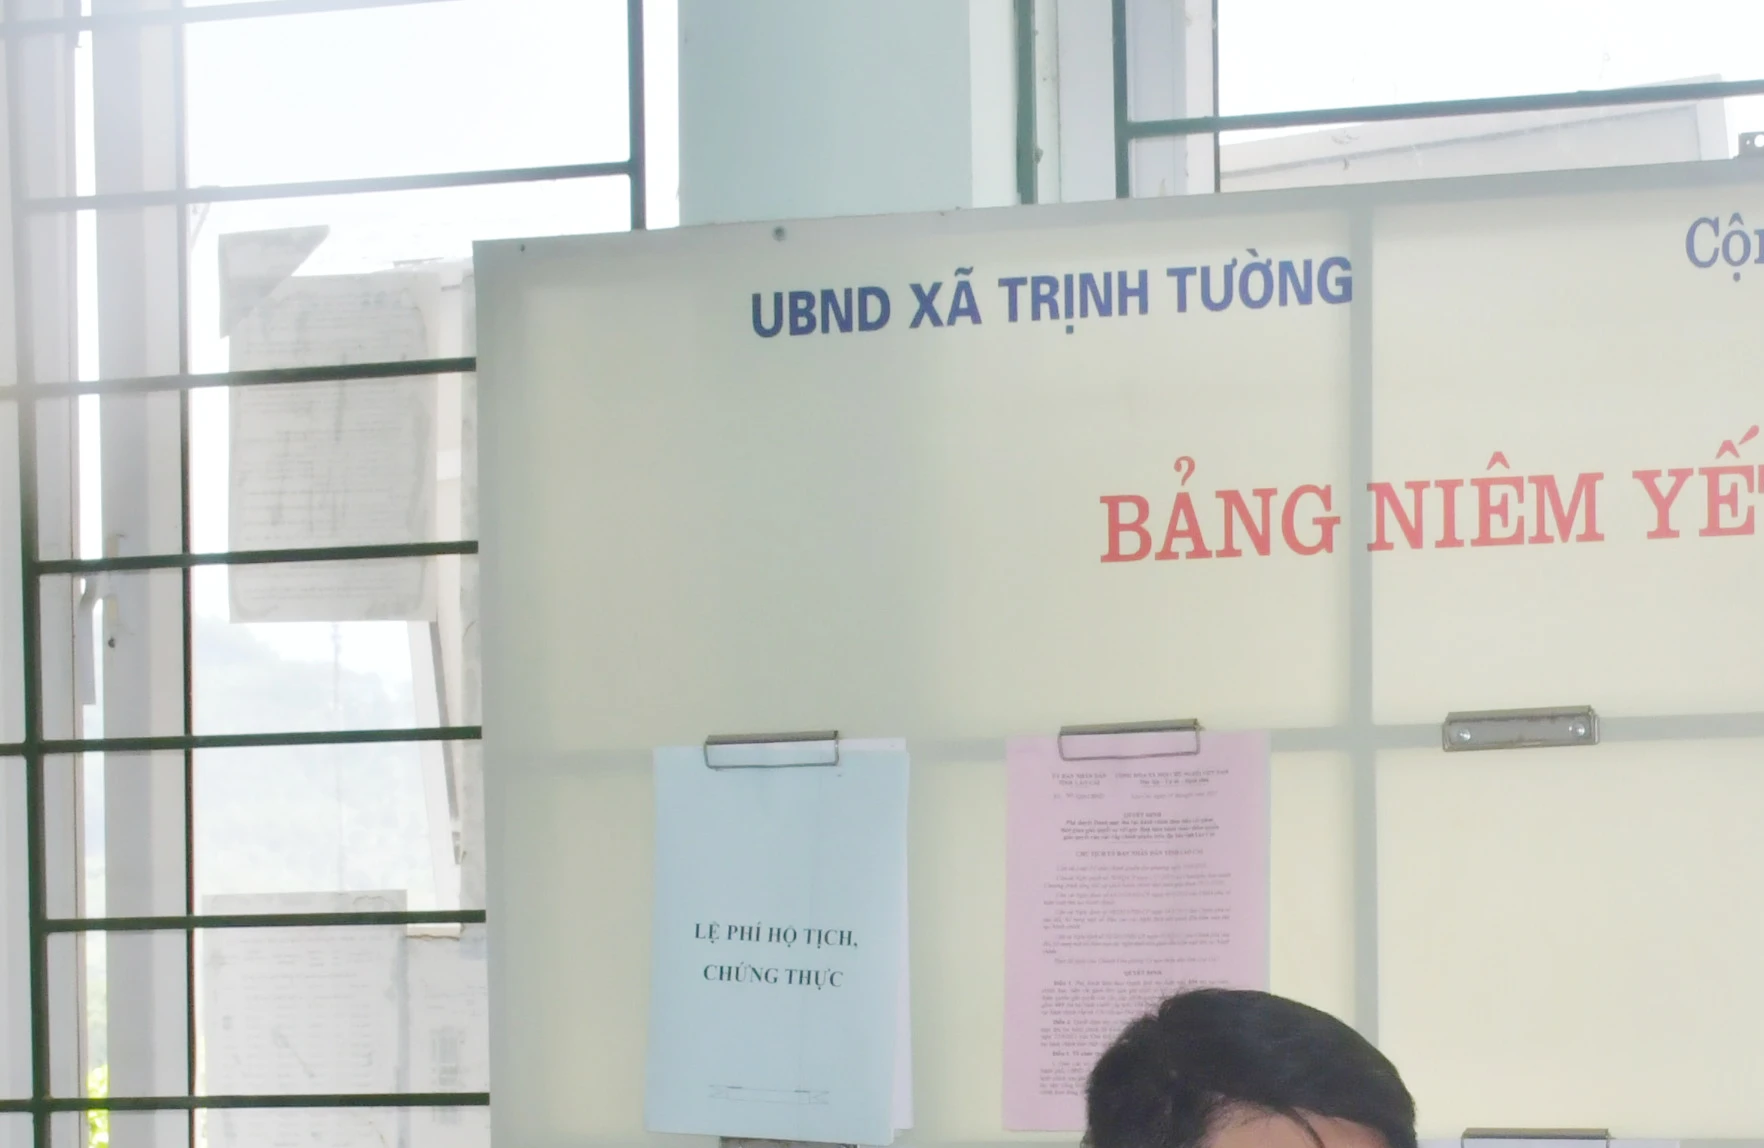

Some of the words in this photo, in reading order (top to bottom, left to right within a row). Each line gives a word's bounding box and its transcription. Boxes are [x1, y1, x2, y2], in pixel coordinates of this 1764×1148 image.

[752, 286, 891, 338] UBND
[909, 267, 982, 328] XÃ
[999, 270, 1148, 334] TRỊNH
[1167, 249, 1353, 312] TƯỜNG
[1100, 456, 1341, 563] BẢNG
[1367, 451, 1604, 551] NIÊM
[694, 922, 720, 945] LỆ
[727, 921, 761, 942] PHÍ
[768, 925, 797, 947] HỘ
[803, 927, 859, 949] TỊCH,
[703, 961, 779, 984] CHỨNG
[785, 967, 844, 990] THỰC
